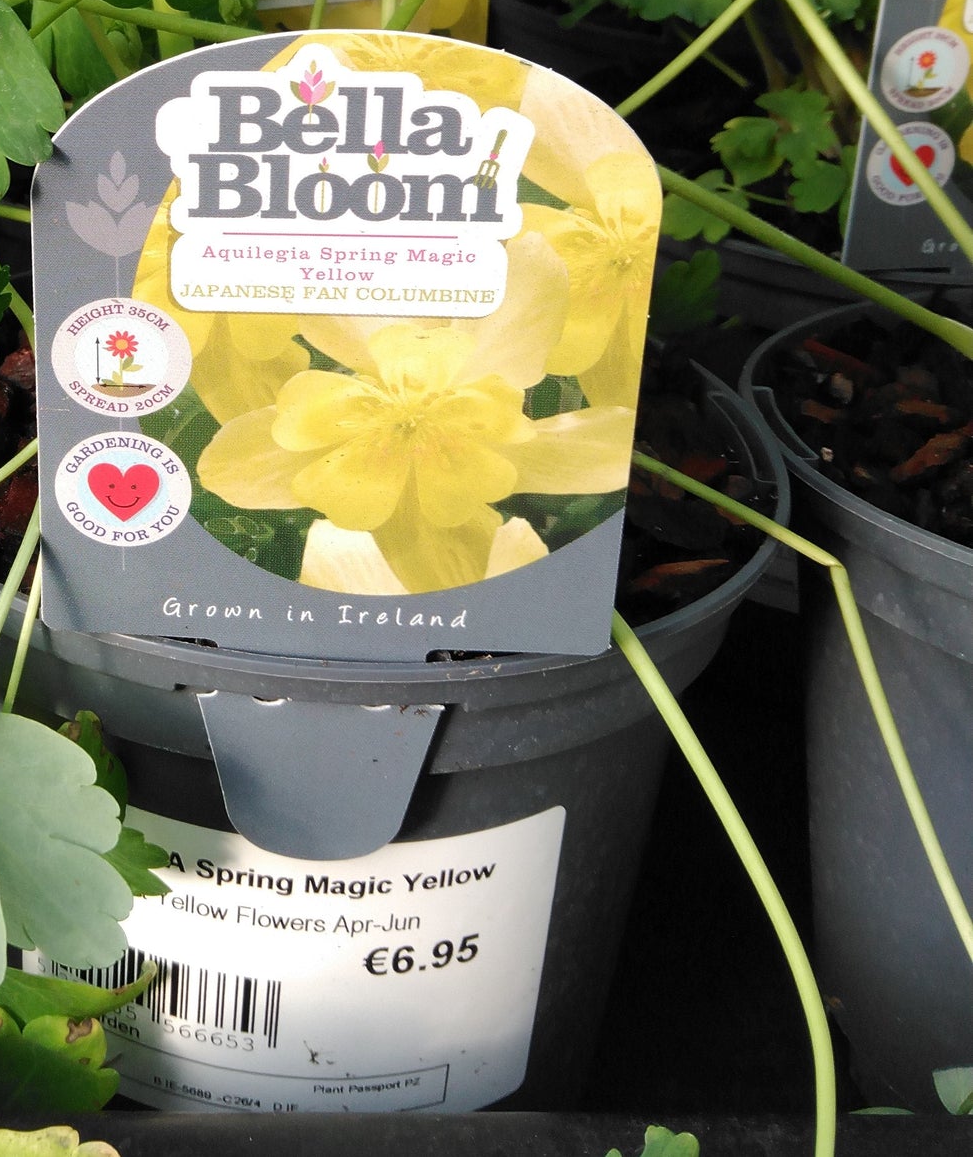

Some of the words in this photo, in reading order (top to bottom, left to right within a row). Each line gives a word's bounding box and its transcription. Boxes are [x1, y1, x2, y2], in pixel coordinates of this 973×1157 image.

[208, 86, 474, 156] Bella
[188, 153, 504, 222] Bloom
[202, 246, 311, 263] Aquilegia
[320, 247, 398, 265] Spring
[407, 249, 477, 266] Magic
[299, 268, 375, 282] Yellow
[180, 285, 295, 300] JAPANESE
[303, 286, 349, 301] FAN
[355, 287, 496, 304] COLUMBINE
[67, 304, 124, 336] HEIGHT
[128, 307, 171, 332] 35CM
[68, 380, 129, 413] SPREAD
[135, 383, 175, 411] 20CM
[65, 436, 163, 475] GARDENING
[161, 456, 180, 475] IS
[66, 500, 106, 538] GOOD
[111, 528, 150, 542] FOR
[150, 504, 180, 534] YOU
[163, 597, 262, 619] Grown
[287, 605, 315, 622] in
[337, 604, 467, 628] Ireland
[196, 858, 293, 896] Spring
[304, 874, 393, 900] Magic
[403, 863, 497, 892] Yellow
[237, 905, 326, 933] Flowers
[333, 913, 420, 938] Apr-Jun
[363, 933, 480, 976] €6.95
[163, 1019, 255, 1052] 566653
[313, 1084, 344, 1094] Plant
[348, 1080, 401, 1094] Passport
[405, 1076, 421, 1087] PZ
